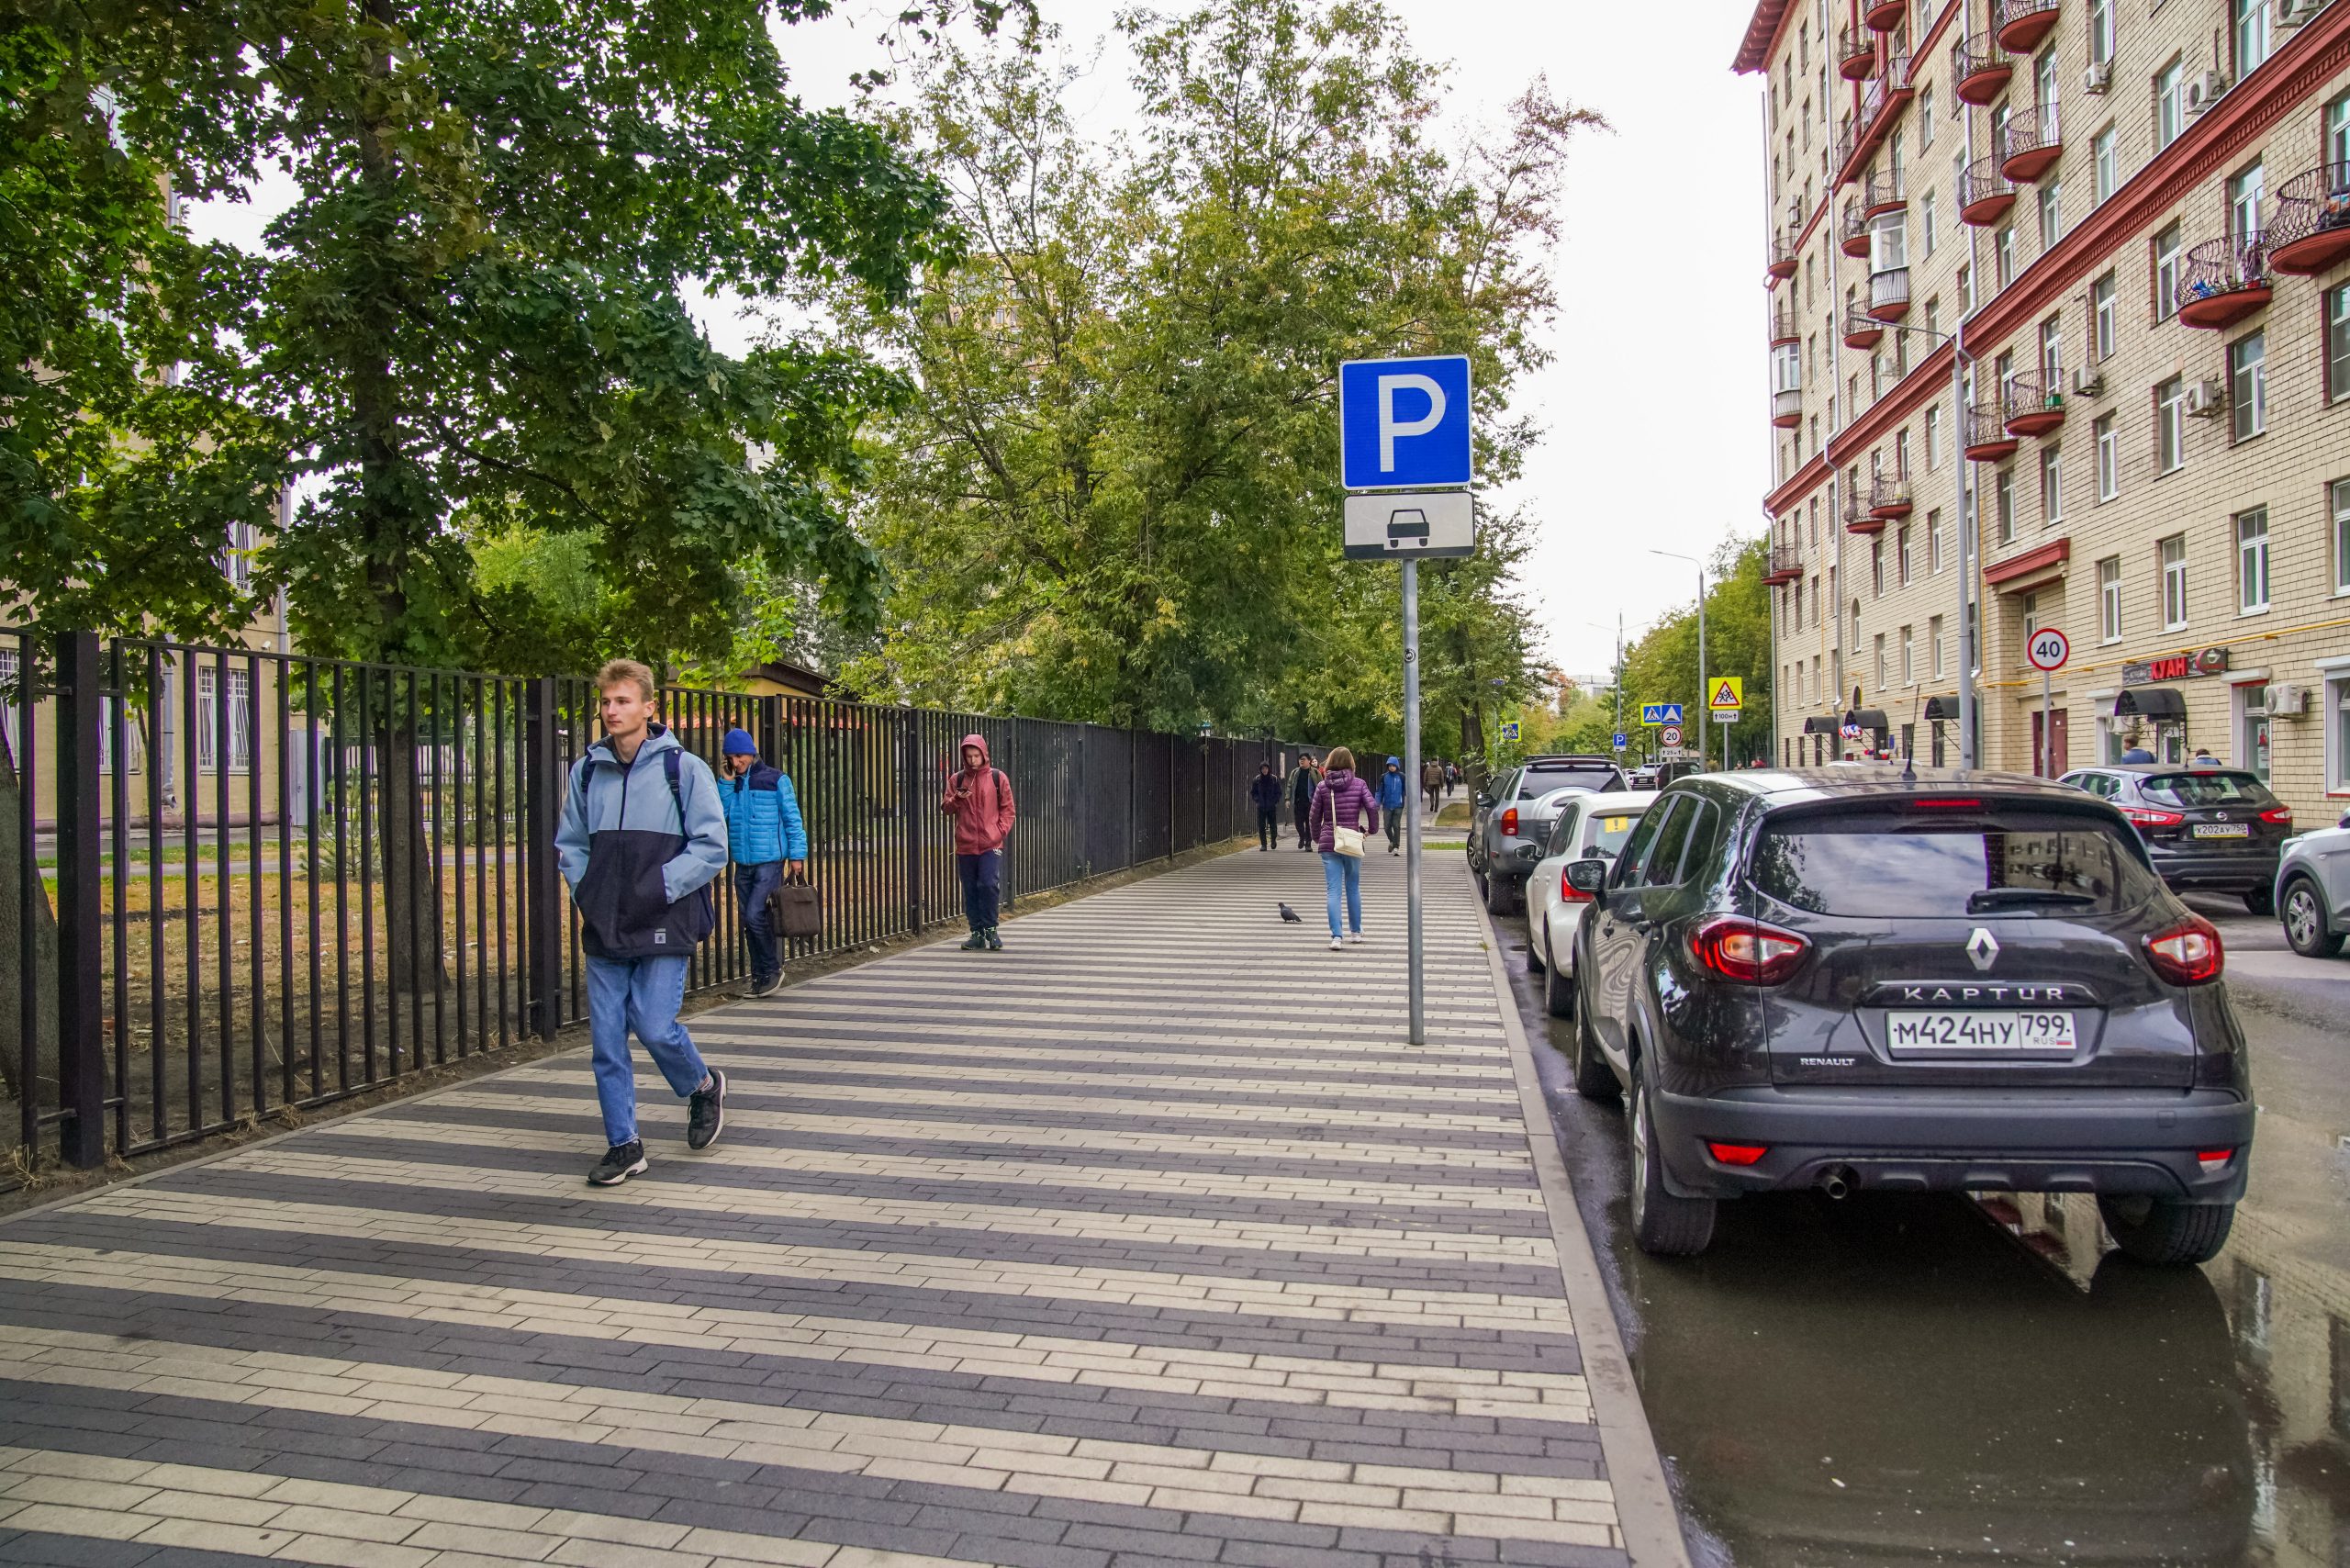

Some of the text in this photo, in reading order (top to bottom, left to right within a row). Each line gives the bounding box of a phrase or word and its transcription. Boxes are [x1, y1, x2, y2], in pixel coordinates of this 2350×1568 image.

[1378, 374, 1446, 473] P
[2036, 641, 2061, 658] 40
[2150, 656, 2187, 680] ХУАН
[1616, 735, 1624, 745] P
[1666, 733, 1678, 741] 20
[1904, 987, 2064, 1001] KAPTUR
[2020, 1014, 2065, 1036] 799
[2033, 1036, 2055, 1046] RUS
[1800, 1057, 1856, 1067] RENAULT
